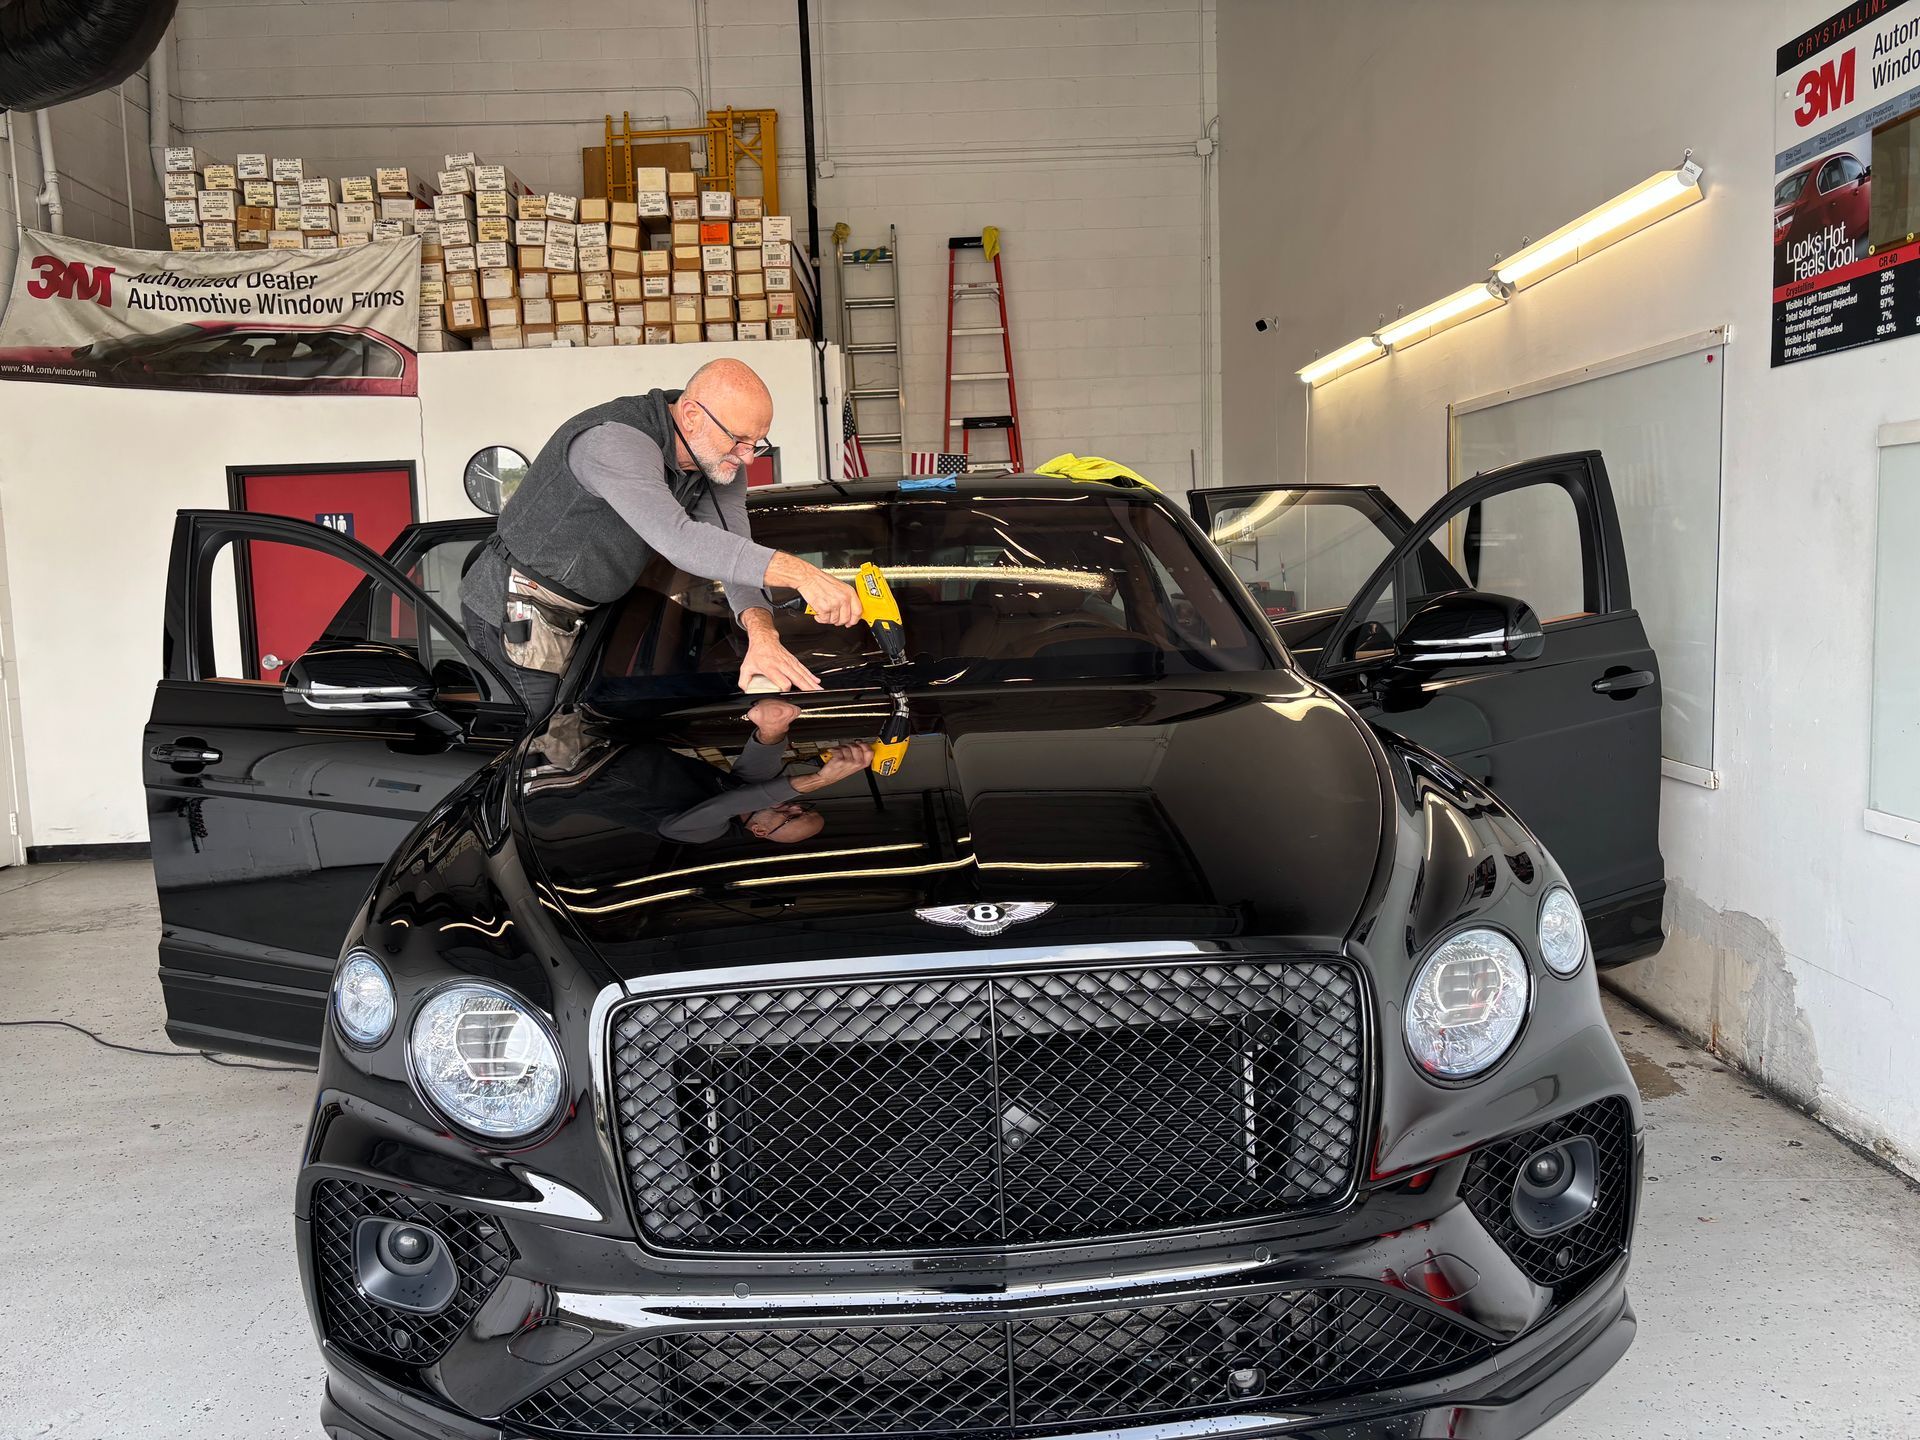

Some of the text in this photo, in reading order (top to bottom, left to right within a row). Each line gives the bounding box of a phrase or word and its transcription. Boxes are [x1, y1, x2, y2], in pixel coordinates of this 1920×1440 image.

[1794, 47, 1856, 128] 3M
[1786, 221, 1849, 264] Looks Hot.
[1794, 238, 1859, 282] Feels Cool.
[26, 255, 319, 308] 3M Authorized Dealer
[126, 287, 405, 315] Automotive Window Films
[1786, 270, 1895, 311] Visible Light Transmitted 39%
[1785, 320, 1806, 335] Infrared
[1880, 296, 1895, 309] 97%
[1786, 283, 1895, 322] Total Solar Energy Rejected 60%
[1784, 347, 1792, 358] UV
[1792, 343, 1816, 356] Rejection
[1877, 322, 1897, 336] 99.9%
[1785, 310, 1893, 347] Visible Light Reflected 7%
[0, 364, 97, 378] www.3M.com/windowfilm
[973, 904, 999, 922] B
